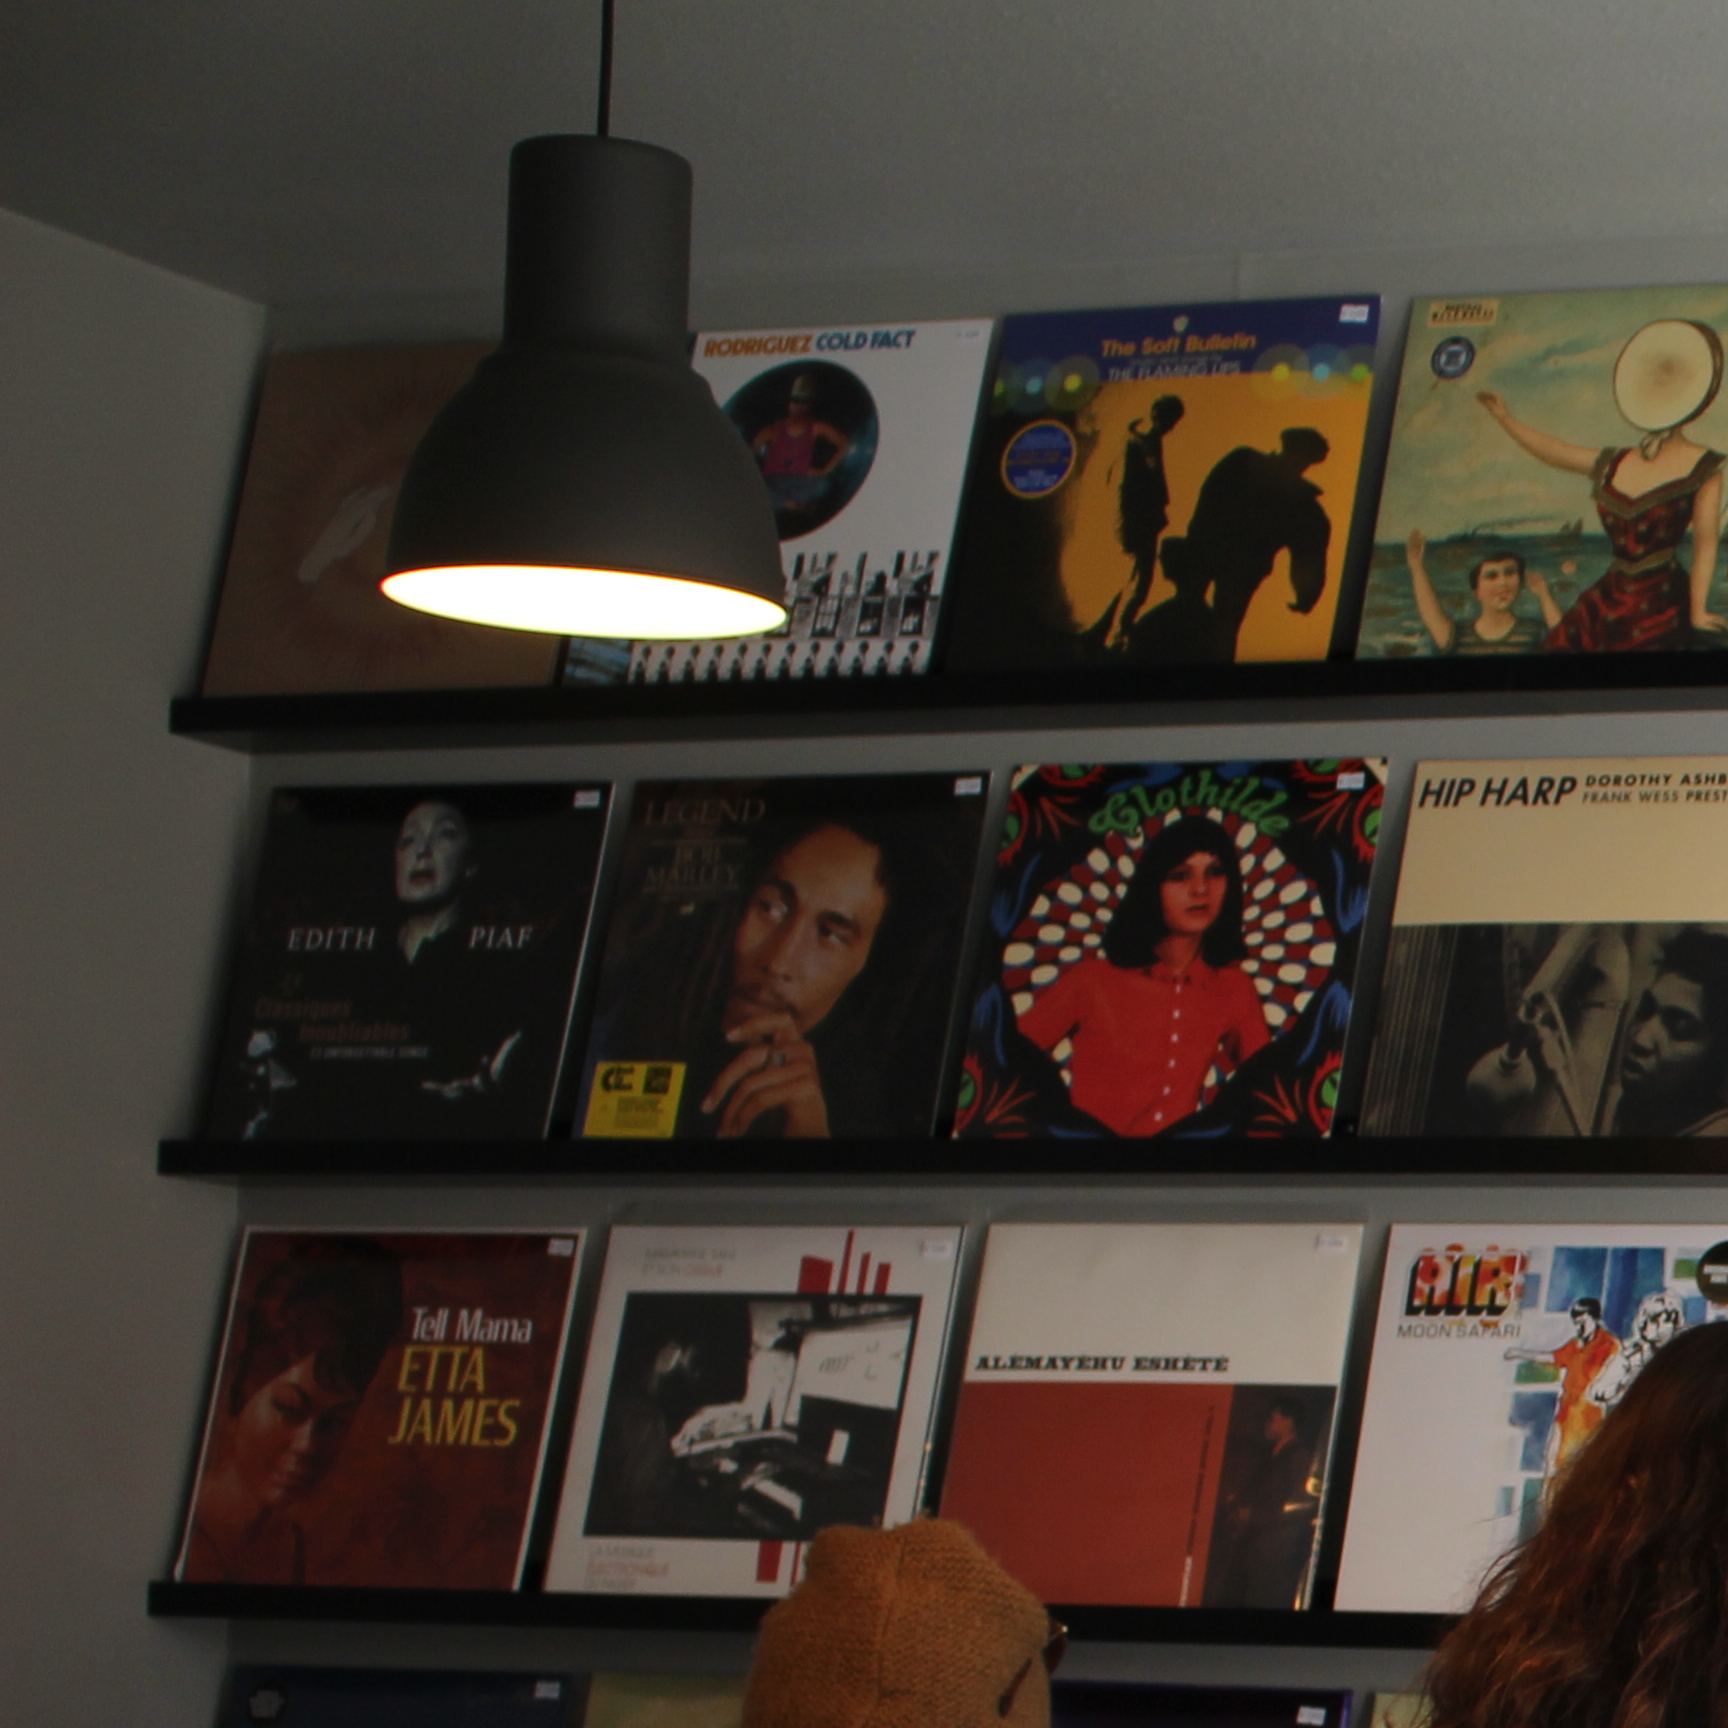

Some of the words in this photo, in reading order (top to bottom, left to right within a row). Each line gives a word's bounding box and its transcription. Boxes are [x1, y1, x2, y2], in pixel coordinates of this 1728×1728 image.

[704, 335, 813, 358] RODRIGUEZ
[815, 331, 867, 351] COLD
[870, 329, 916, 349] FACT
[1102, 340, 1136, 356] The
[1142, 337, 1180, 355] Soft
[1185, 334, 1256, 353] Bulletin
[1108, 367, 1132, 382] THE
[1136, 363, 1207, 380] FLAMING
[1210, 361, 1241, 376] LIPS
[1418, 778, 1477, 808] HIP
[1480, 776, 1577, 807] HARP
[1585, 773, 1672, 787] DOROTHY
[1088, 776, 1290, 838] Clothilde
[1582, 789, 1635, 803] FRANK
[1639, 789, 1678, 803] WESS
[645, 799, 765, 826] LEGEND
[644, 864, 740, 886] MARLEY
[287, 925, 377, 951] EDITH
[467, 925, 534, 950] PIAF
[1404, 1250, 1522, 1317] AIR
[411, 1307, 450, 1342] Tell
[455, 1309, 533, 1344] Mama
[1396, 1322, 1443, 1339] MOON
[1449, 1321, 1521, 1339] SAFARI
[397, 1346, 486, 1395] ETTA
[386, 1396, 521, 1447] JAMES
